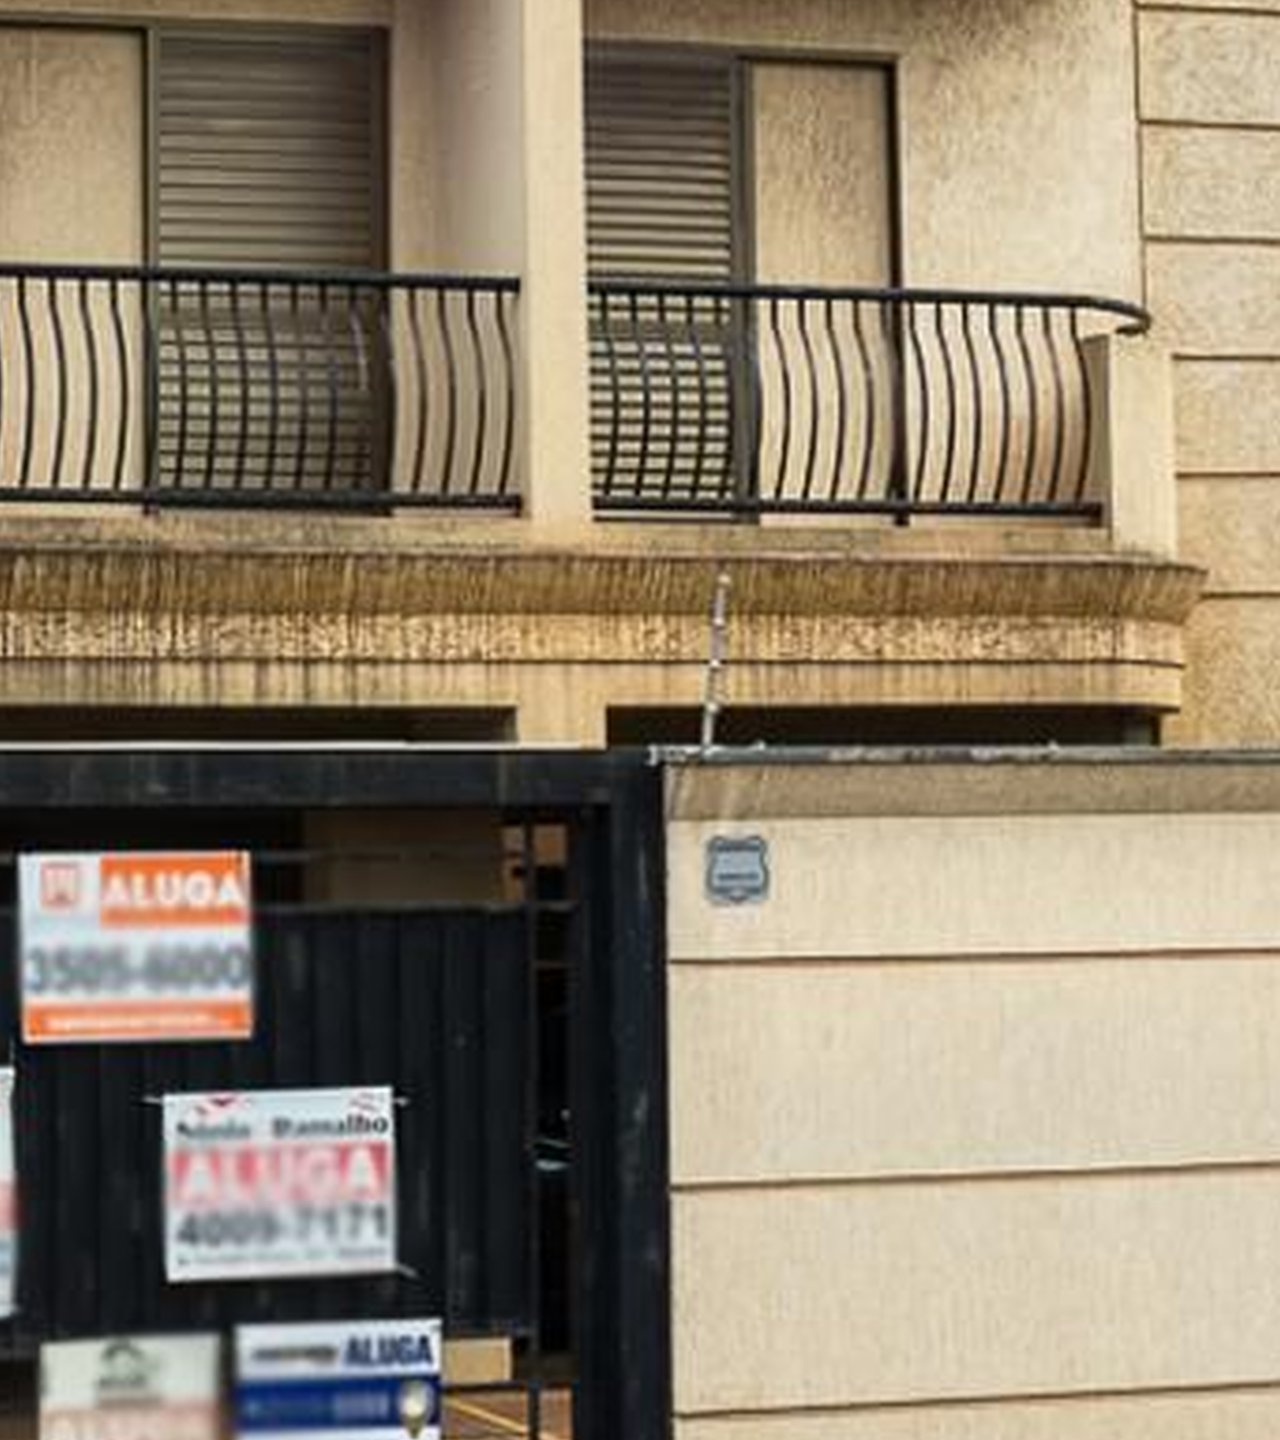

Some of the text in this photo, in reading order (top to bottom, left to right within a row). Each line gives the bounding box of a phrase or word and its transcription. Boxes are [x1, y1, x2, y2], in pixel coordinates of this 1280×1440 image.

[101, 871, 246, 908] ALUGA
[175, 1146, 387, 1203] ALUGA
[344, 1335, 434, 1365] ALUGA
